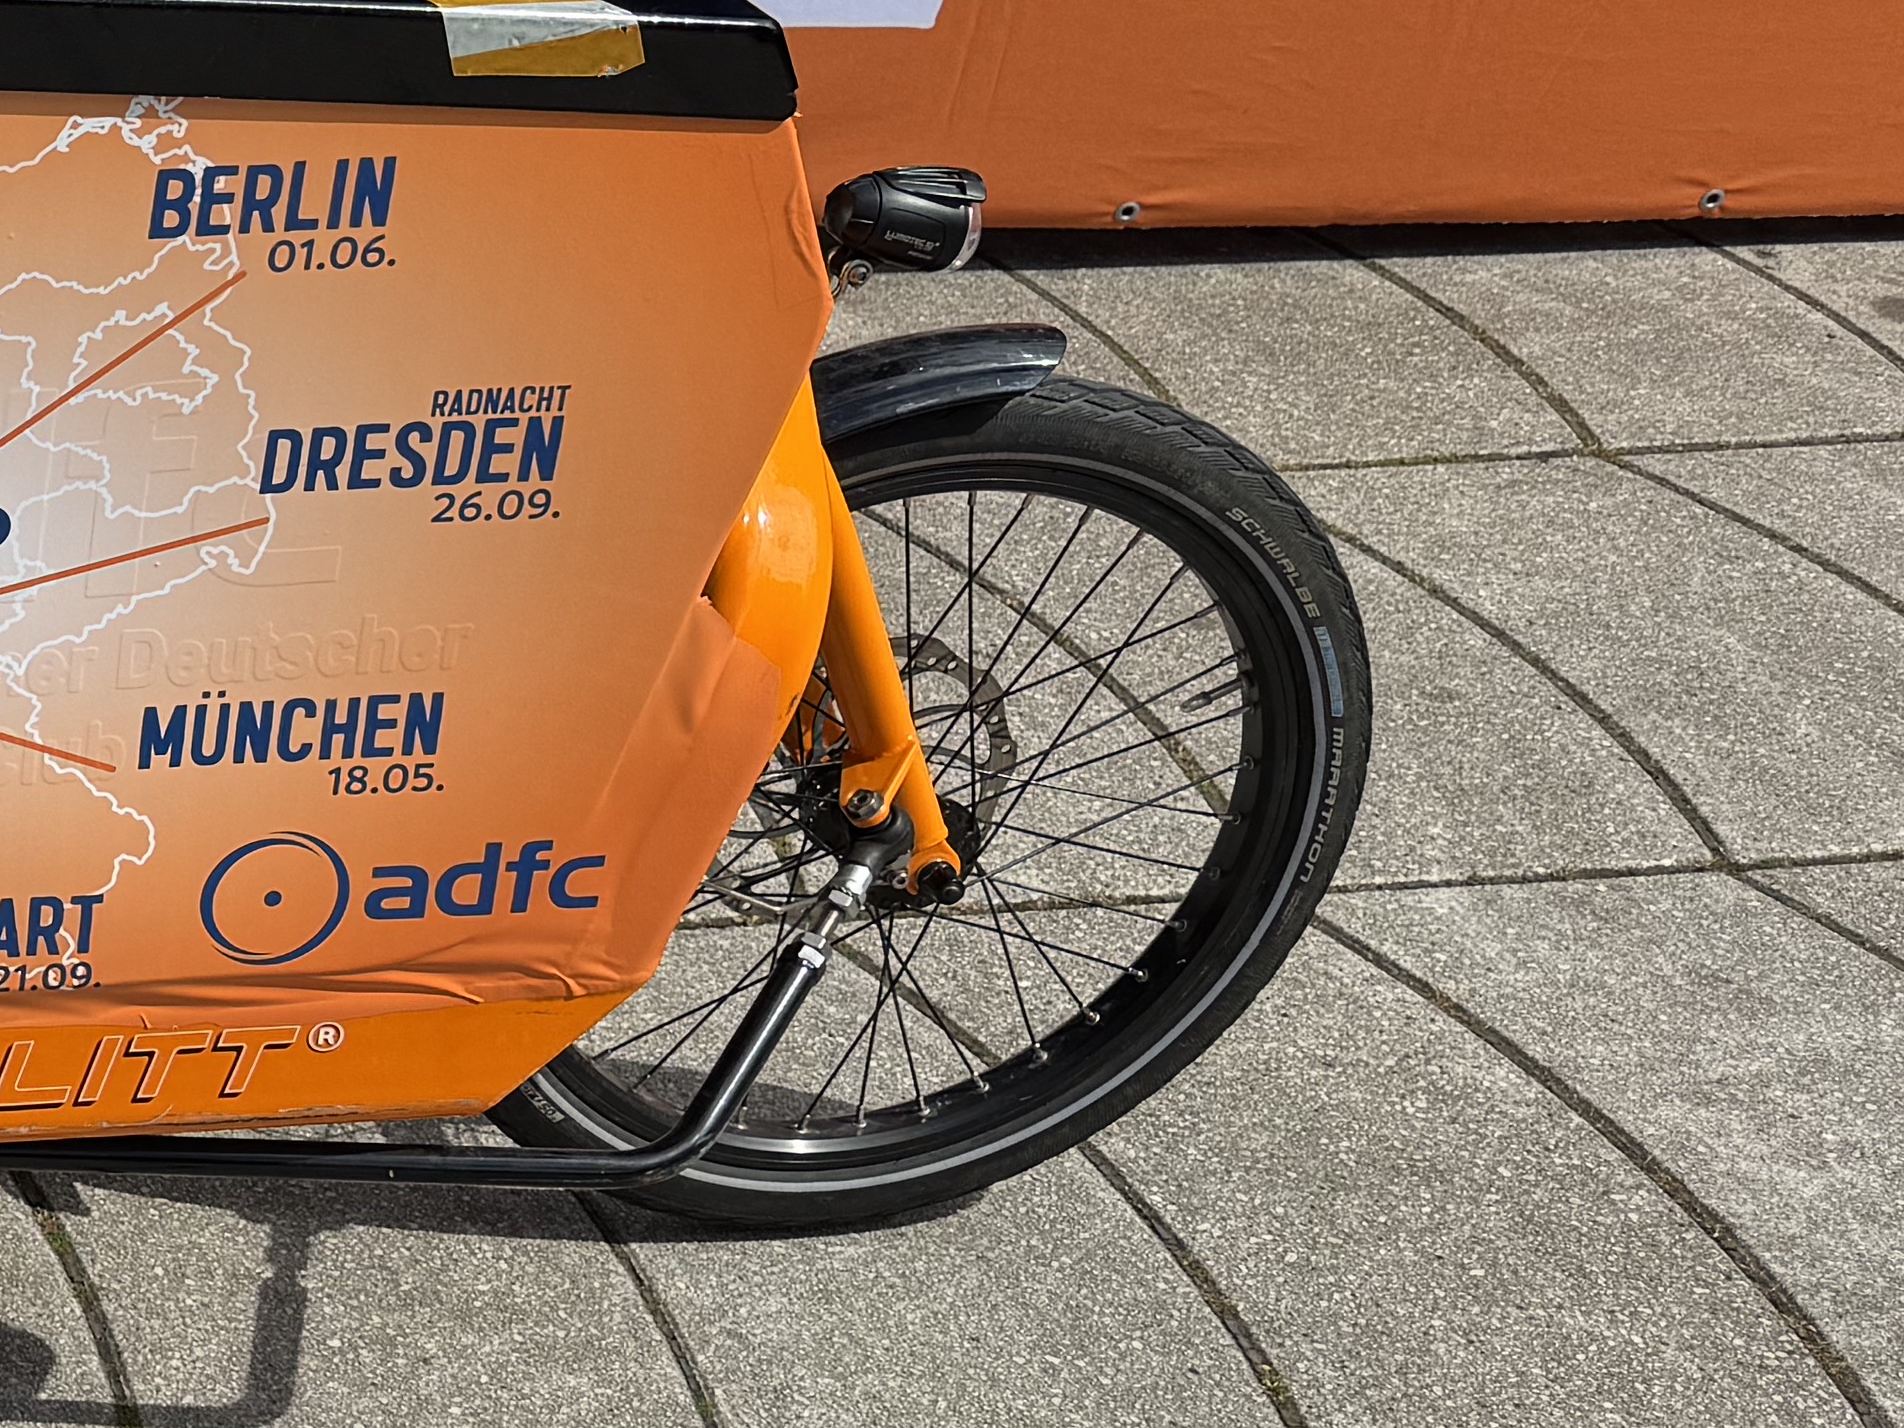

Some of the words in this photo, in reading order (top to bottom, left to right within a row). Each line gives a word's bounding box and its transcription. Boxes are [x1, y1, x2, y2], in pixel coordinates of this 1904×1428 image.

[147, 154, 398, 241] BERLIN
[267, 235, 398, 274] 01.06.
[429, 384, 572, 418] RADNACHT
[258, 415, 566, 495] DRESDEN
[430, 488, 562, 525] 26.09.
[136, 689, 446, 771] MÜNCHEN
[1225, 506, 1321, 620] SCHWALBE
[1299, 727, 1345, 883] MARATHON
[328, 762, 446, 799] 18.05.
[363, 838, 606, 921] adfc
